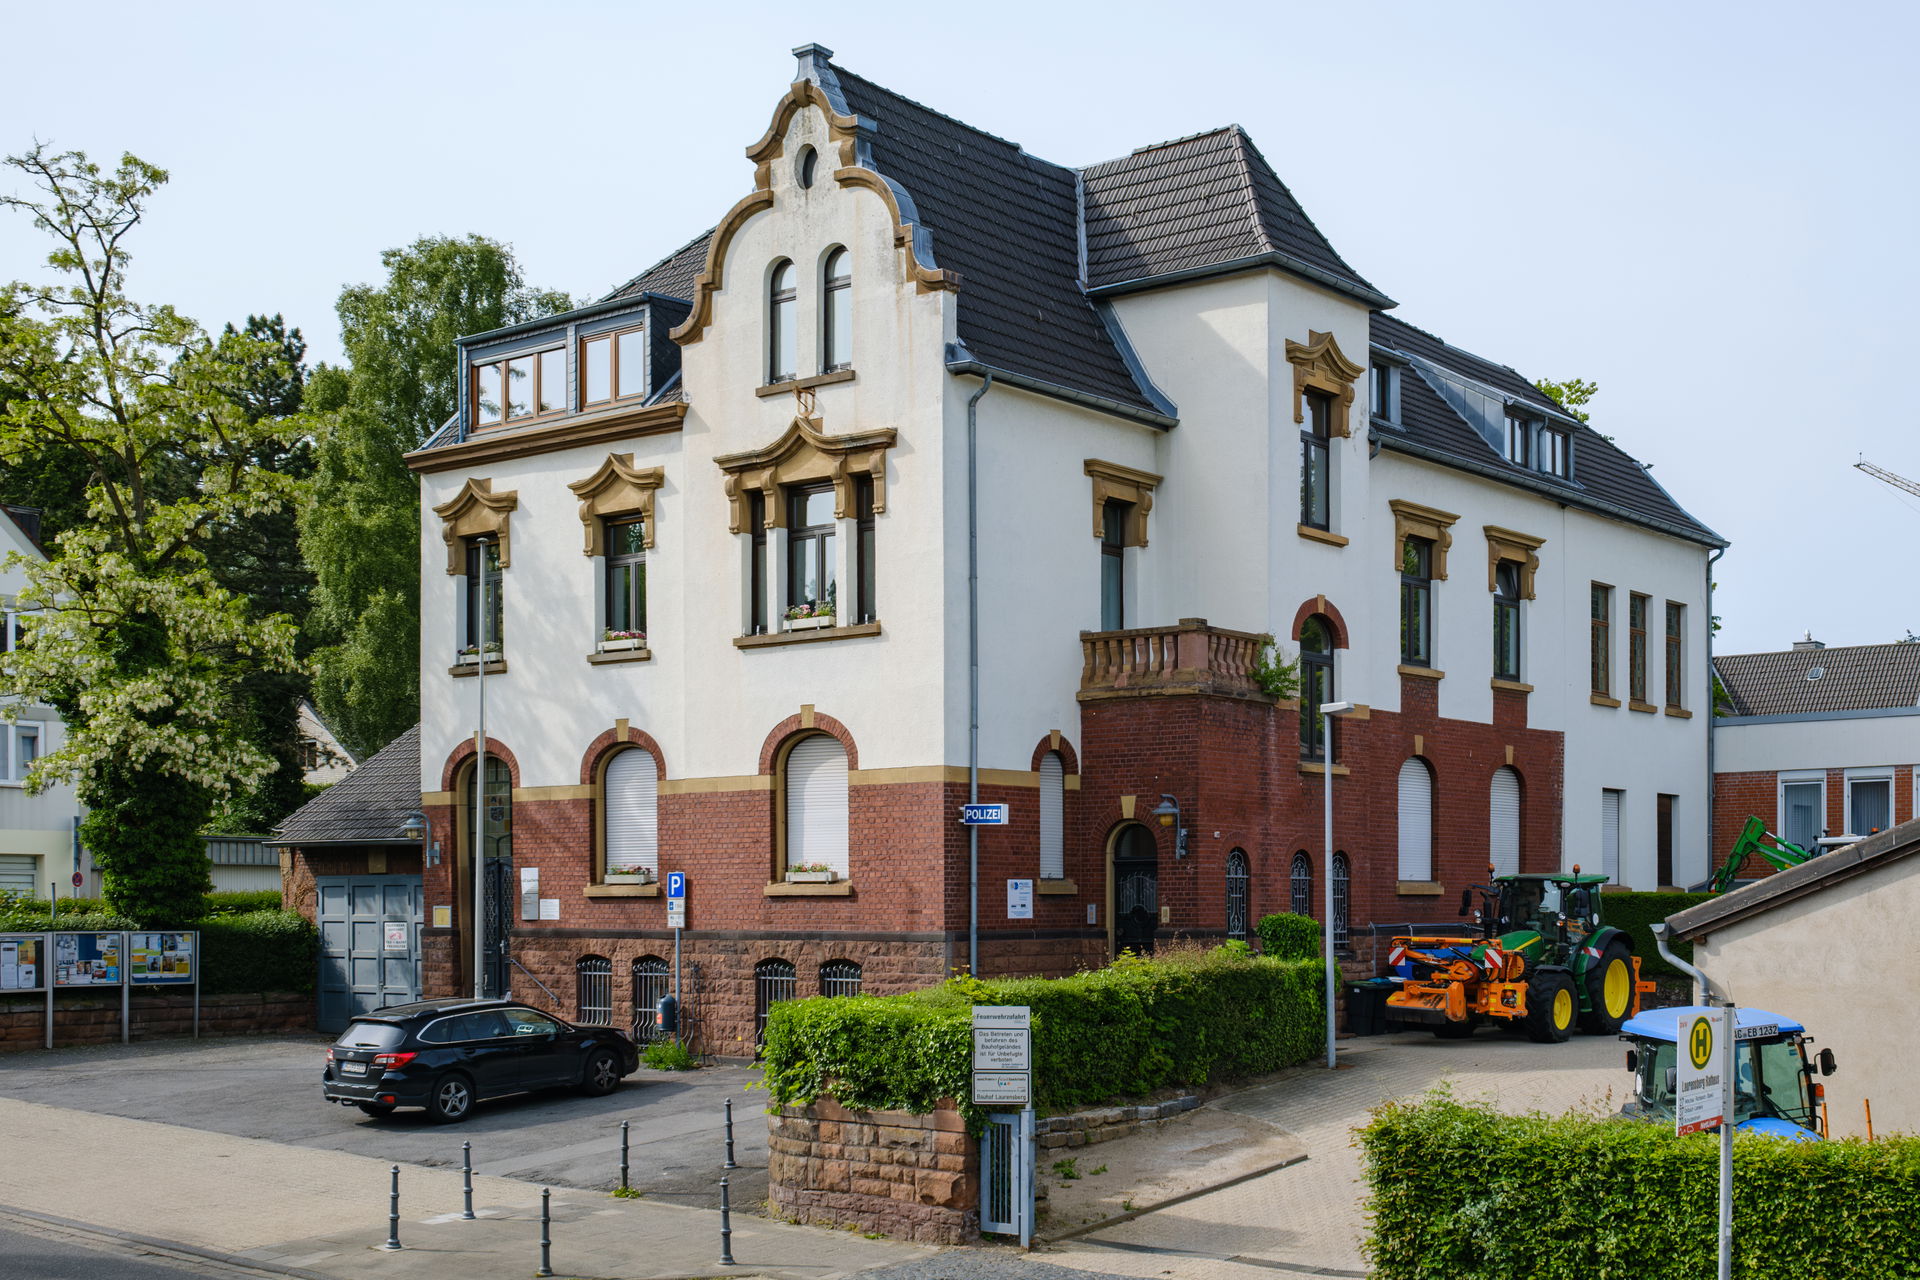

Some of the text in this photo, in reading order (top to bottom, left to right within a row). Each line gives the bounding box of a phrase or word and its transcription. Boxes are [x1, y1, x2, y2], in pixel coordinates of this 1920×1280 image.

[966, 809, 1001, 820] POLIZEI
[671, 876, 681, 895] P
[1748, 1028, 1757, 1037] EB
[1759, 1025, 1777, 1035] 1232
[1696, 1029, 1706, 1058] H
[1681, 1078, 1705, 1092] Laurensberg
